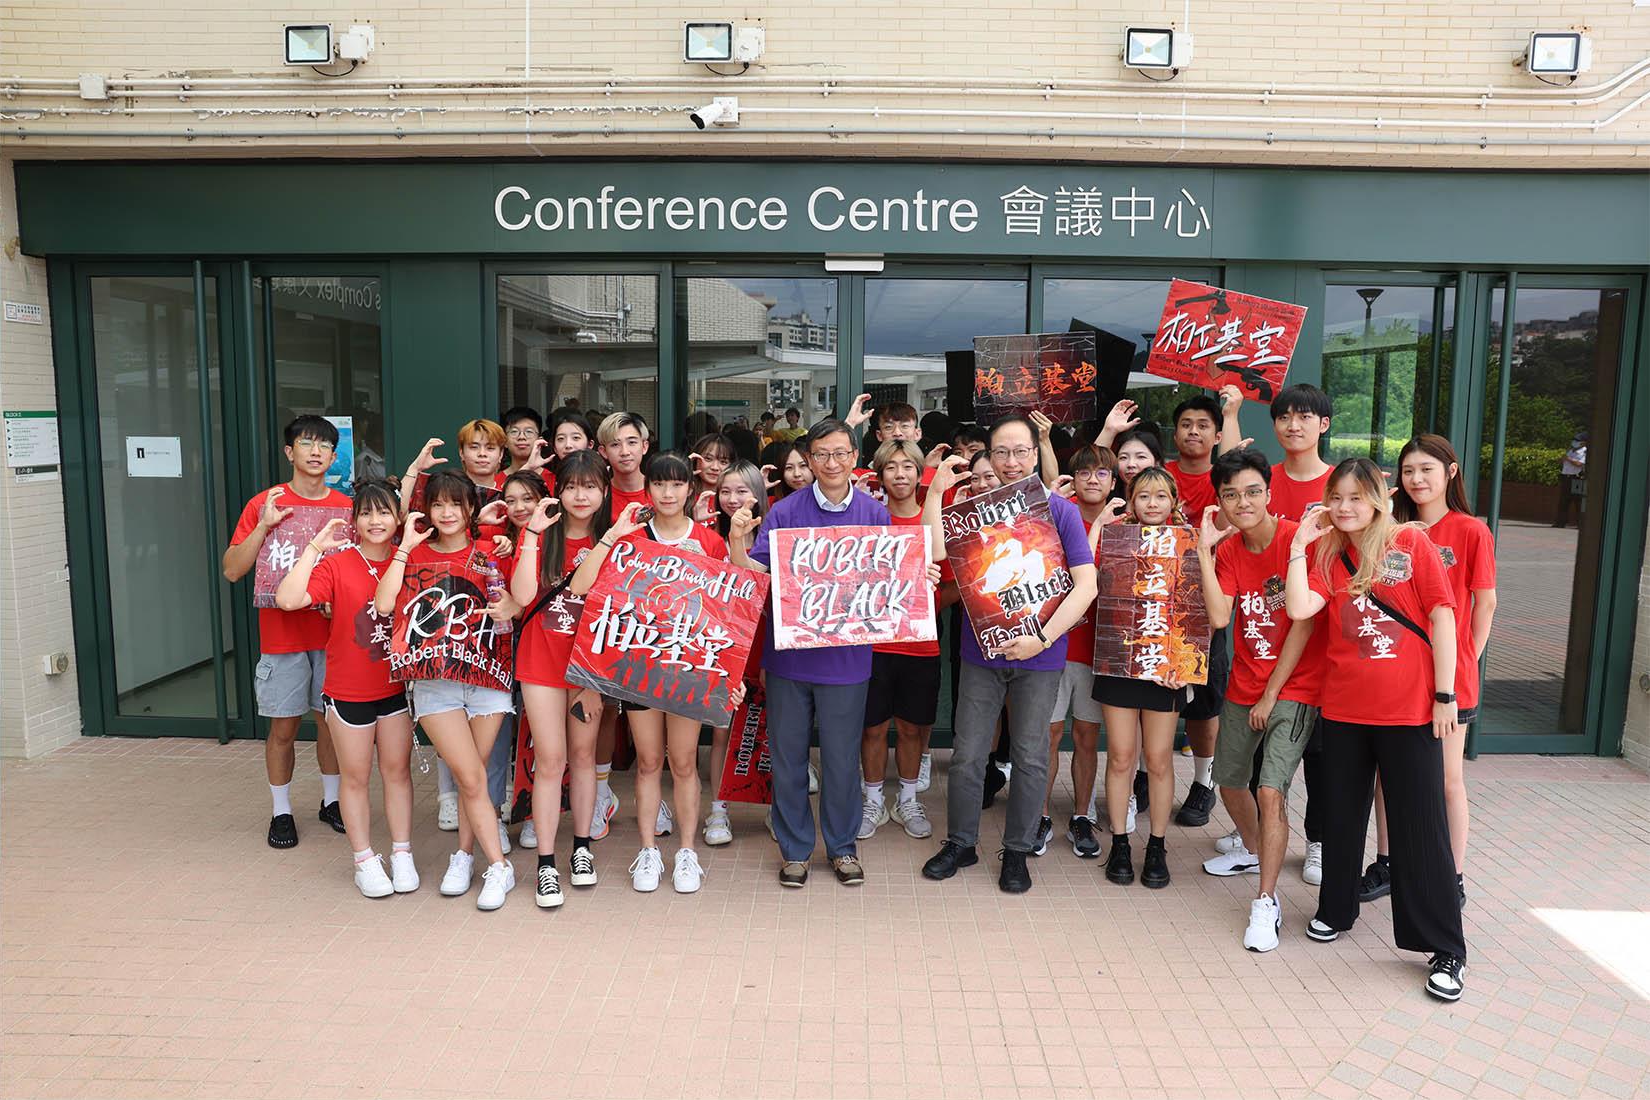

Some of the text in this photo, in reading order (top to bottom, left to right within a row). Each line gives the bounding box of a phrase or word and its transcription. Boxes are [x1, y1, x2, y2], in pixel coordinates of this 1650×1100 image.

[494, 184, 979, 233] Conference Centre
[999, 184, 1212, 239] 會議中心
[1156, 310, 1288, 367] 柏立基堂
[975, 361, 1097, 398] 柏立基堂
[943, 490, 1030, 542] Robert
[611, 541, 757, 603] Robert Black Hall
[792, 532, 915, 577] ROBERT
[800, 580, 913, 627] BLACK
[998, 567, 1073, 619] Black
[1134, 527, 1177, 680] 柏立基堂
[590, 595, 736, 677] 柏立基堂
[390, 642, 512, 691] Robert Black Hall
[735, 703, 762, 776] ROBERT
